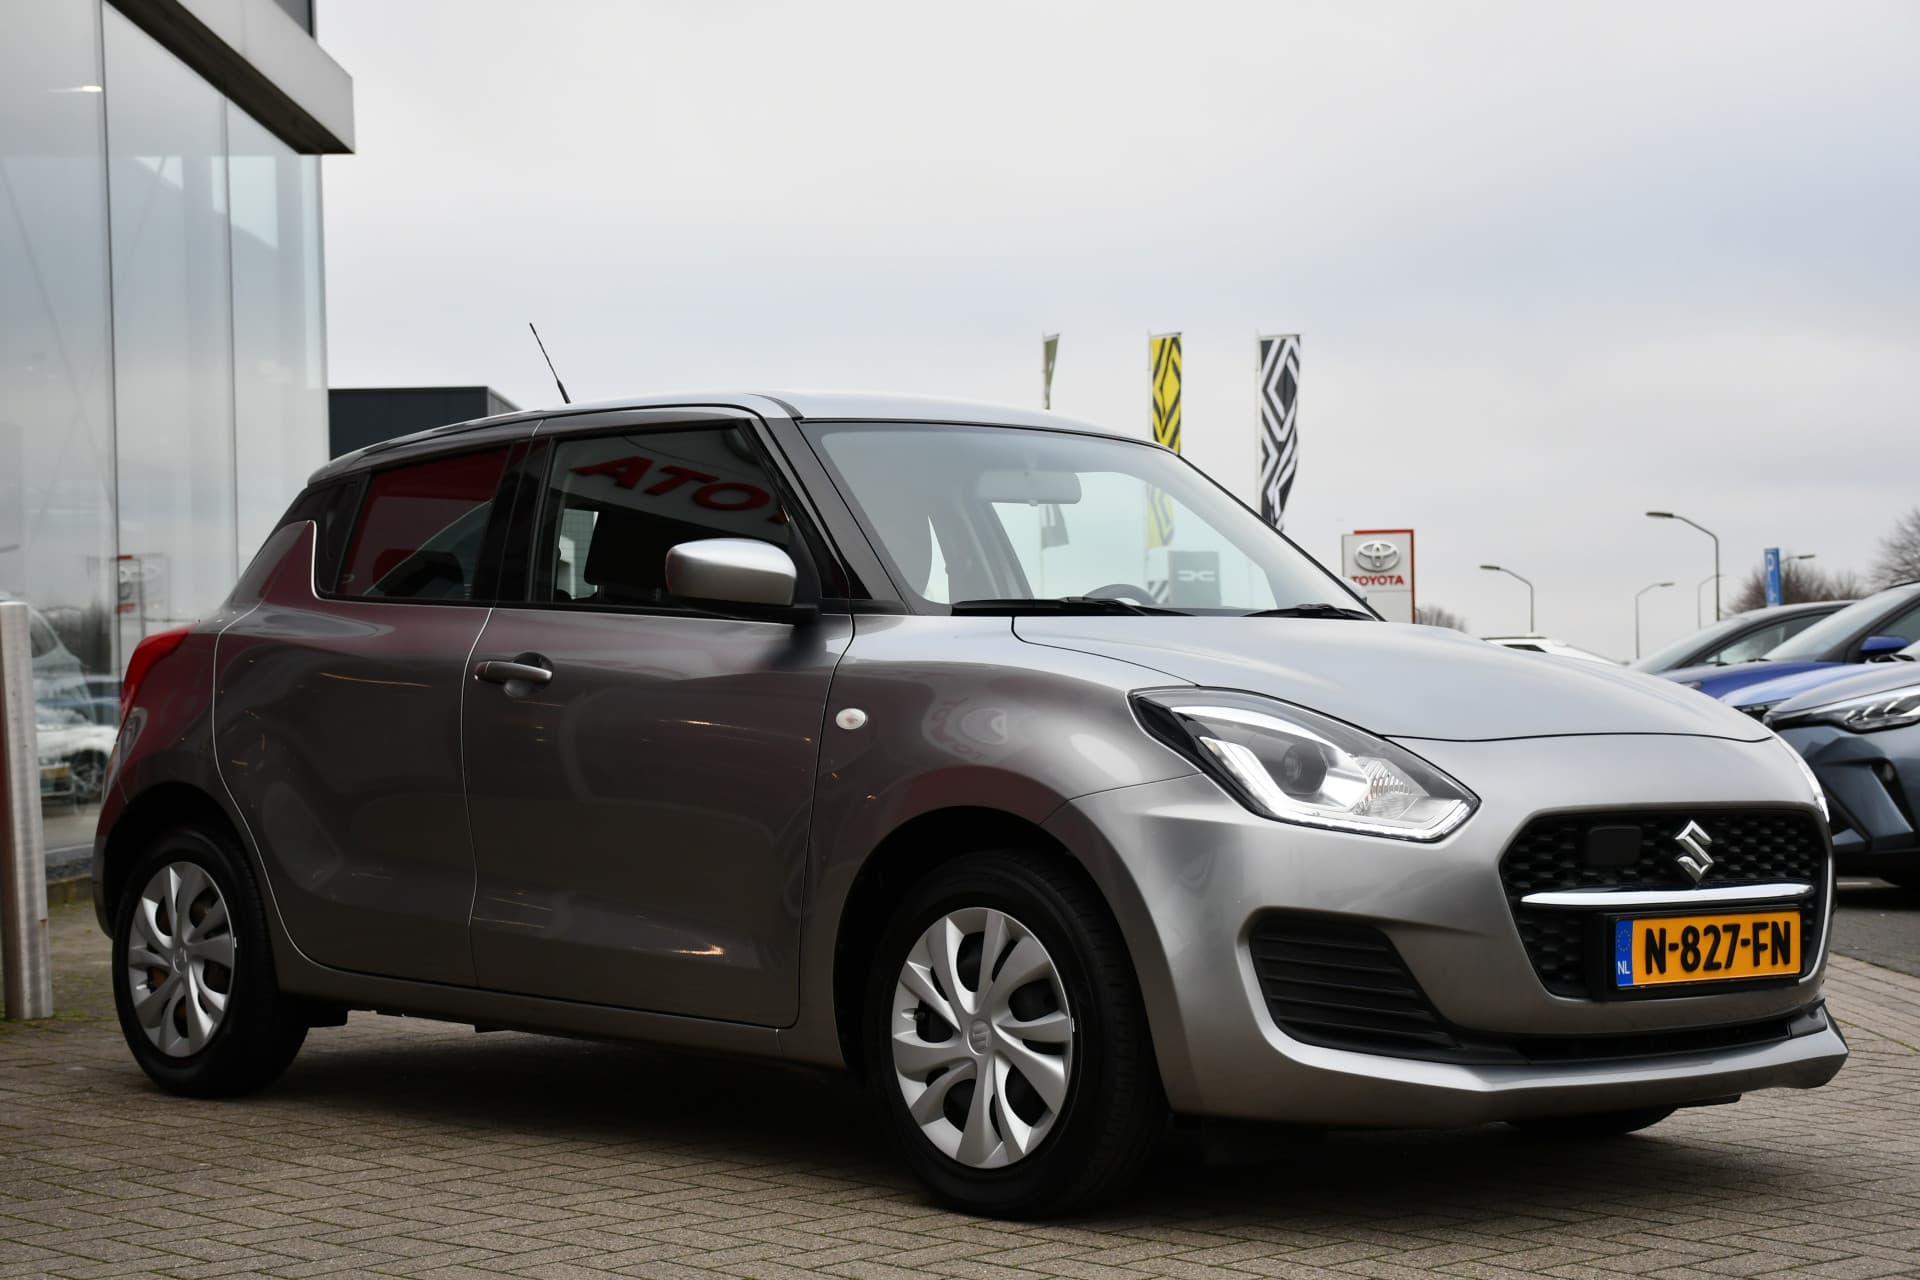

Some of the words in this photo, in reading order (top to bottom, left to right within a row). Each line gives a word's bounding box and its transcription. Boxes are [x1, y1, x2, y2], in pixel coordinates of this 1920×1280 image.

[1352, 575, 1404, 586] TOYOTA
[1645, 921, 1791, 974] N-827-FN
[1617, 960, 1631, 975] NL
